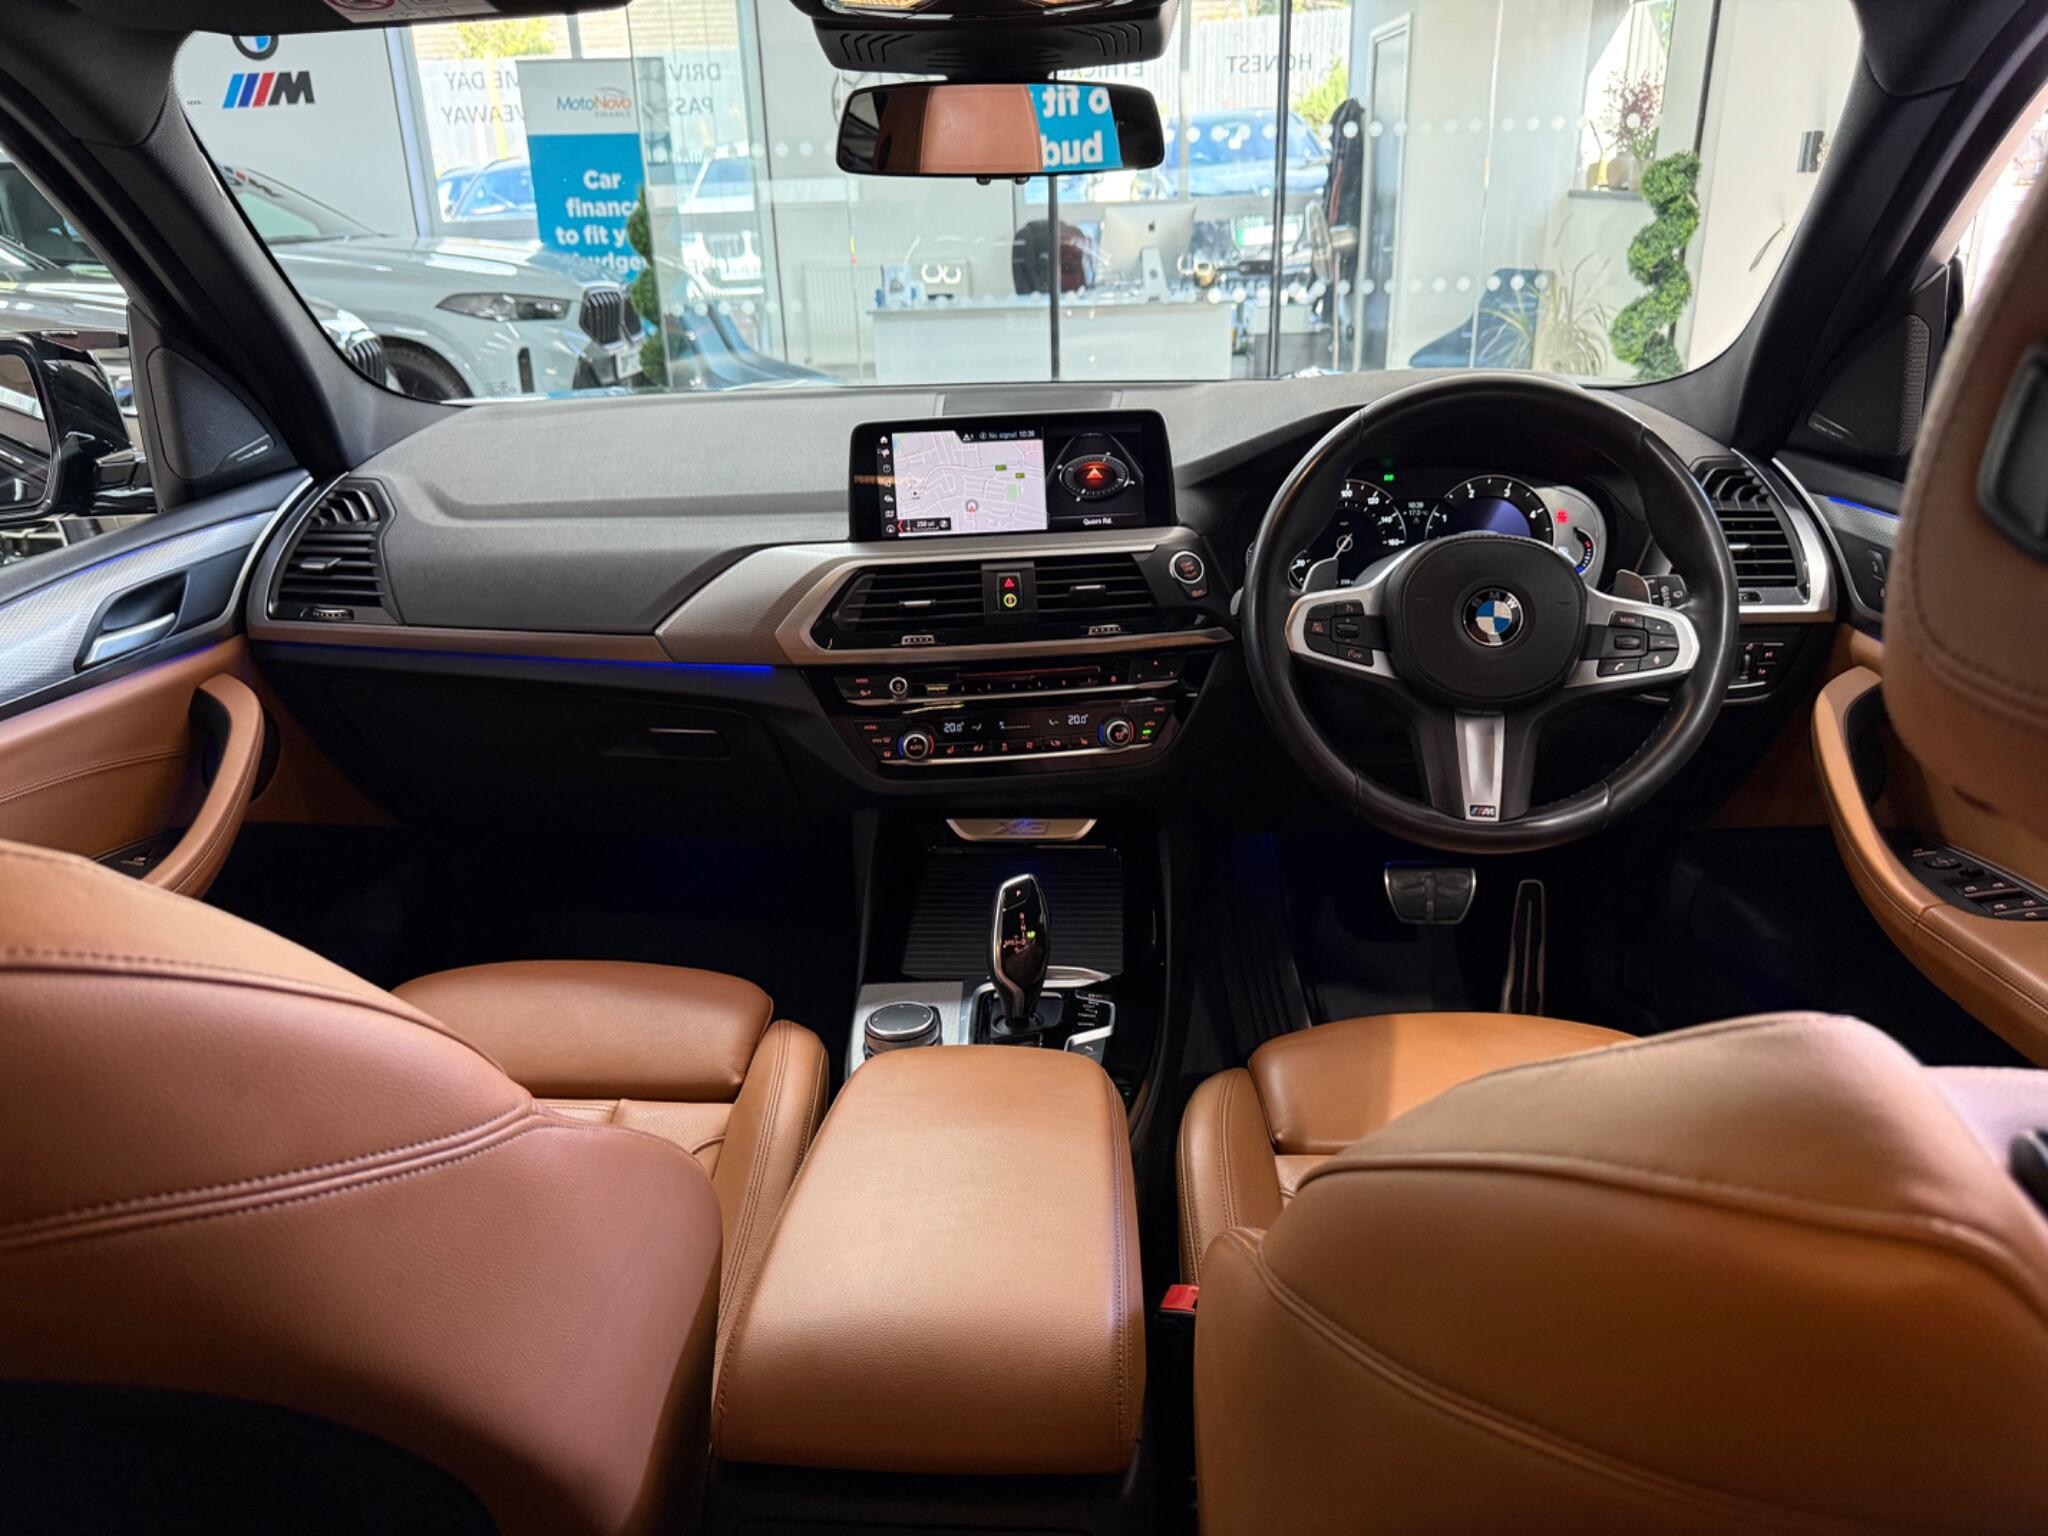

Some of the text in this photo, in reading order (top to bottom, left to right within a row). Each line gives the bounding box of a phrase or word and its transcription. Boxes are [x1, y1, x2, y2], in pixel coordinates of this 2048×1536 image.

[556, 95, 632, 112] MotoNovo
[583, 169, 622, 190] Car
[555, 225, 580, 246] to
[583, 224, 610, 246] fit
[1468, 488, 1475, 499] 2
[1503, 487, 1511, 498] 3
[1442, 514, 1448, 523] 1
[1529, 509, 1537, 519] 4
